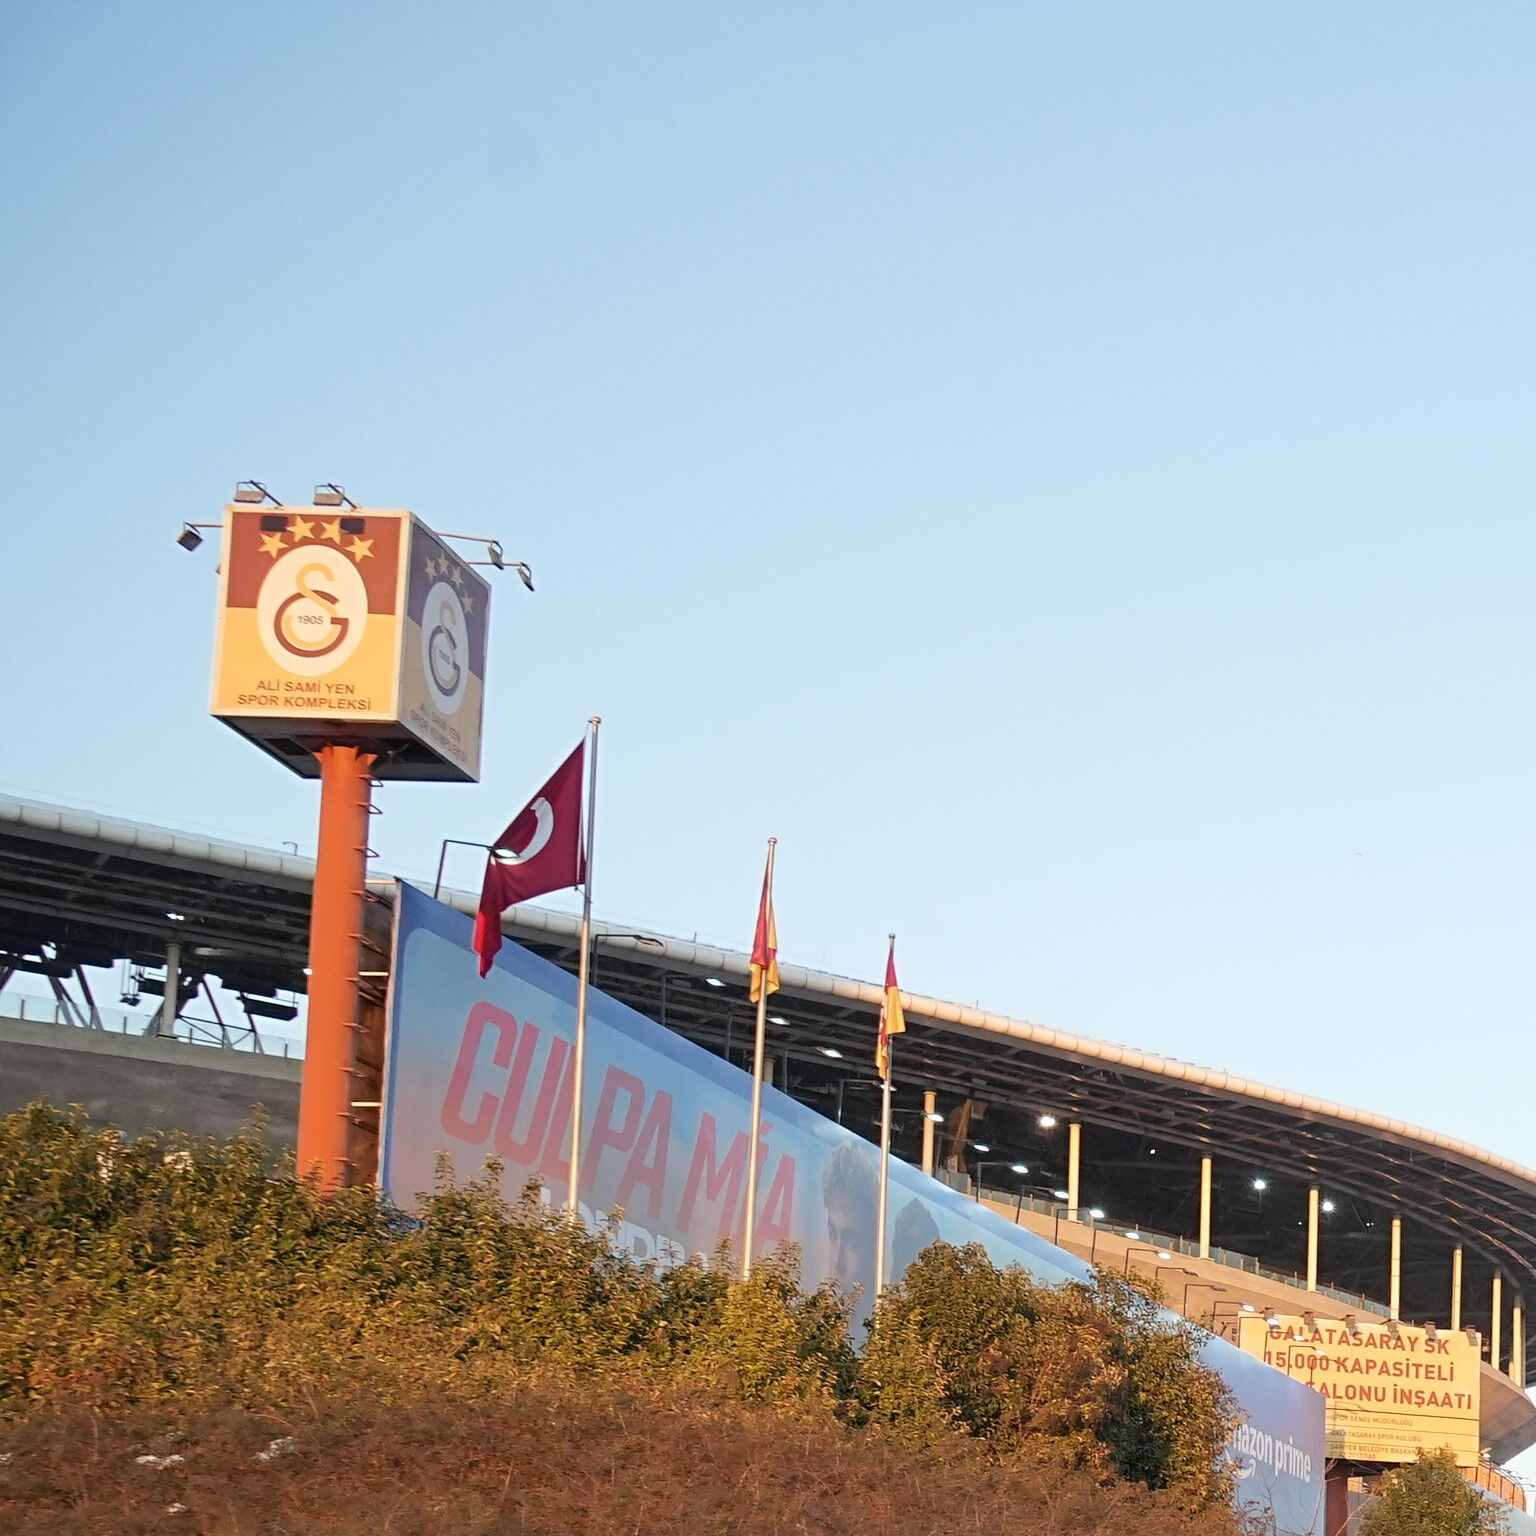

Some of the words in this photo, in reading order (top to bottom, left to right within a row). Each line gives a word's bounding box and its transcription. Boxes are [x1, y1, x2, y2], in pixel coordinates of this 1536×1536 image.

[297, 615, 324, 625] 1905
[256, 679, 280, 691] ALİ
[284, 680, 321, 693] SAMİ
[325, 683, 356, 695] YEN
[237, 694, 279, 706] SPOR
[284, 696, 372, 711] KOMPLEKSİ
[440, 1001, 673, 1221] CULPA
[1270, 1325, 1420, 1353] GALATASARAY
[1424, 1337, 1450, 1356] SK
[1265, 1350, 1330, 1371] 15.000
[1336, 1357, 1455, 1382] KAPASİTELİ
[1393, 1383, 1472, 1410] İNŞAATI
[1232, 1424, 1273, 1465] mazon
[1275, 1436, 1311, 1484] prime
